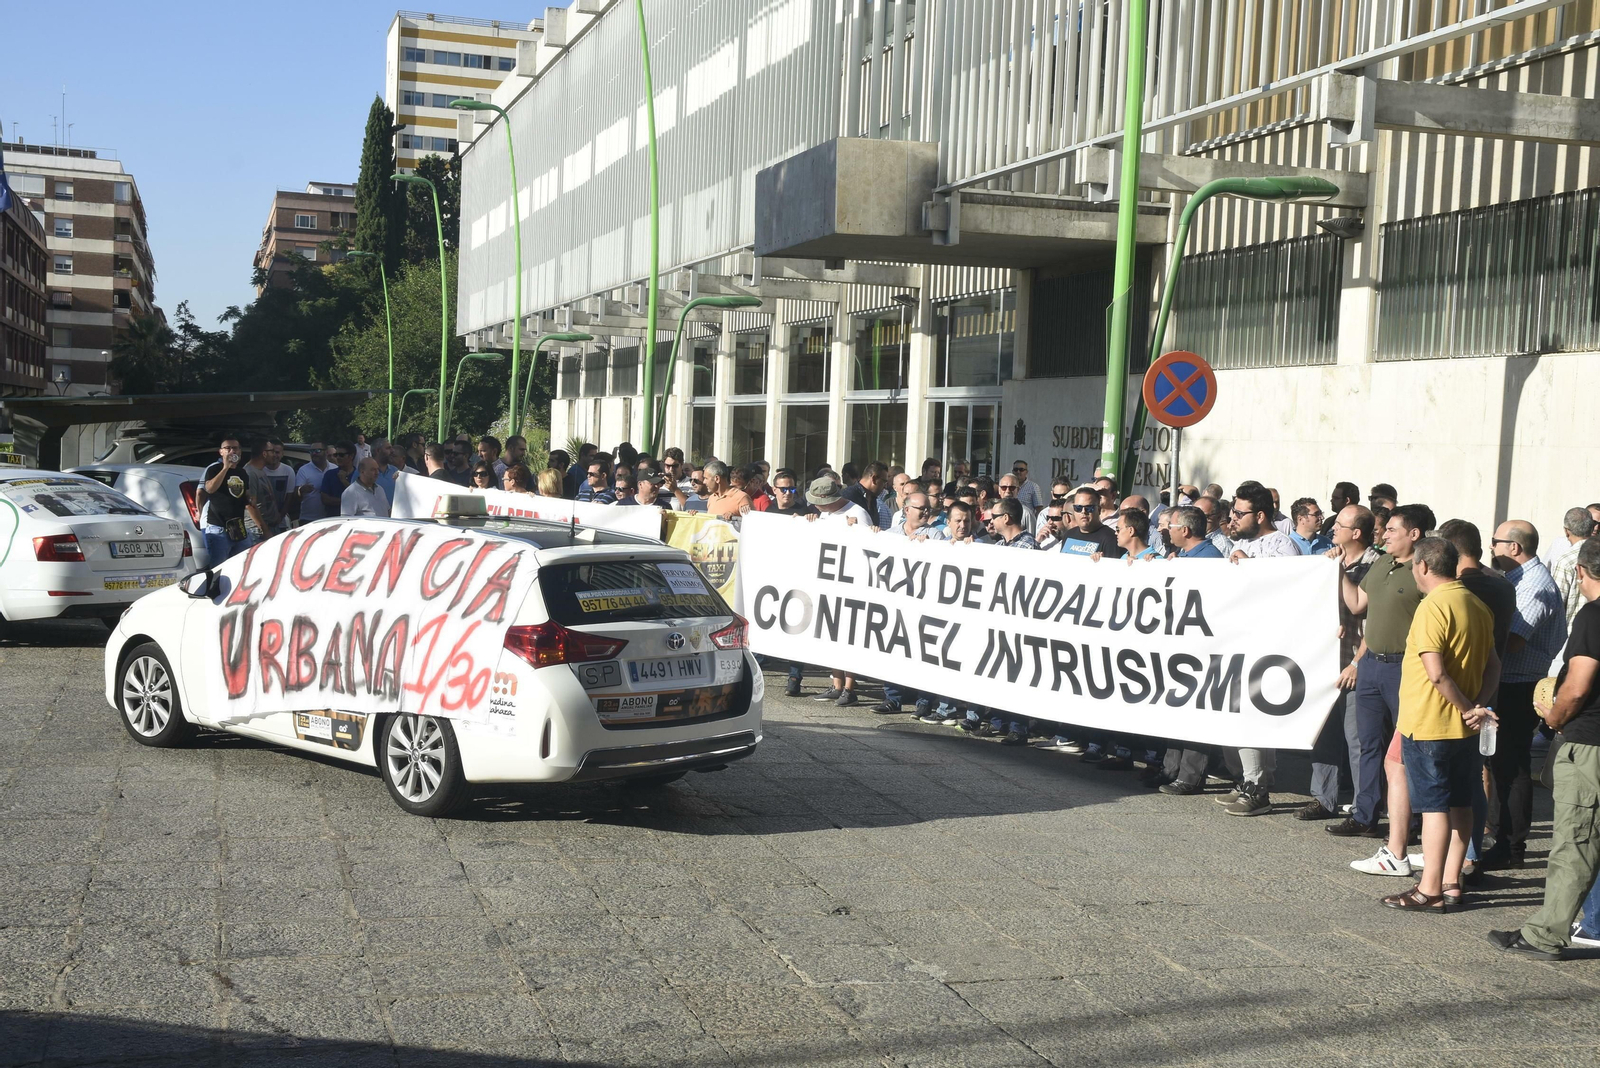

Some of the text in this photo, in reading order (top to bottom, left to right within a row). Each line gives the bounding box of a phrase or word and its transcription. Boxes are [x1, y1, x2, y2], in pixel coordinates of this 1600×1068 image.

[1051, 457, 1079, 481] DEL
[118, 542, 161, 553] 4608 JKX
[225, 524, 526, 625] LICENCIA
[662, 569, 698, 579] SERVICIOS
[707, 564, 726, 573] TAXI
[817, 542, 1214, 637] EL TAXI DE ANDALUCÍA
[582, 595, 646, 612] 957 76 44 44
[661, 595, 677, 605] 957
[220, 601, 492, 713] URBANA 1/30
[753, 585, 1306, 716] CONTRA EL INTRUSISMO
[585, 659, 742, 685] SP 4491 HWV E390
[621, 696, 654, 706] ABONO
[311, 716, 330, 726] ABONO
